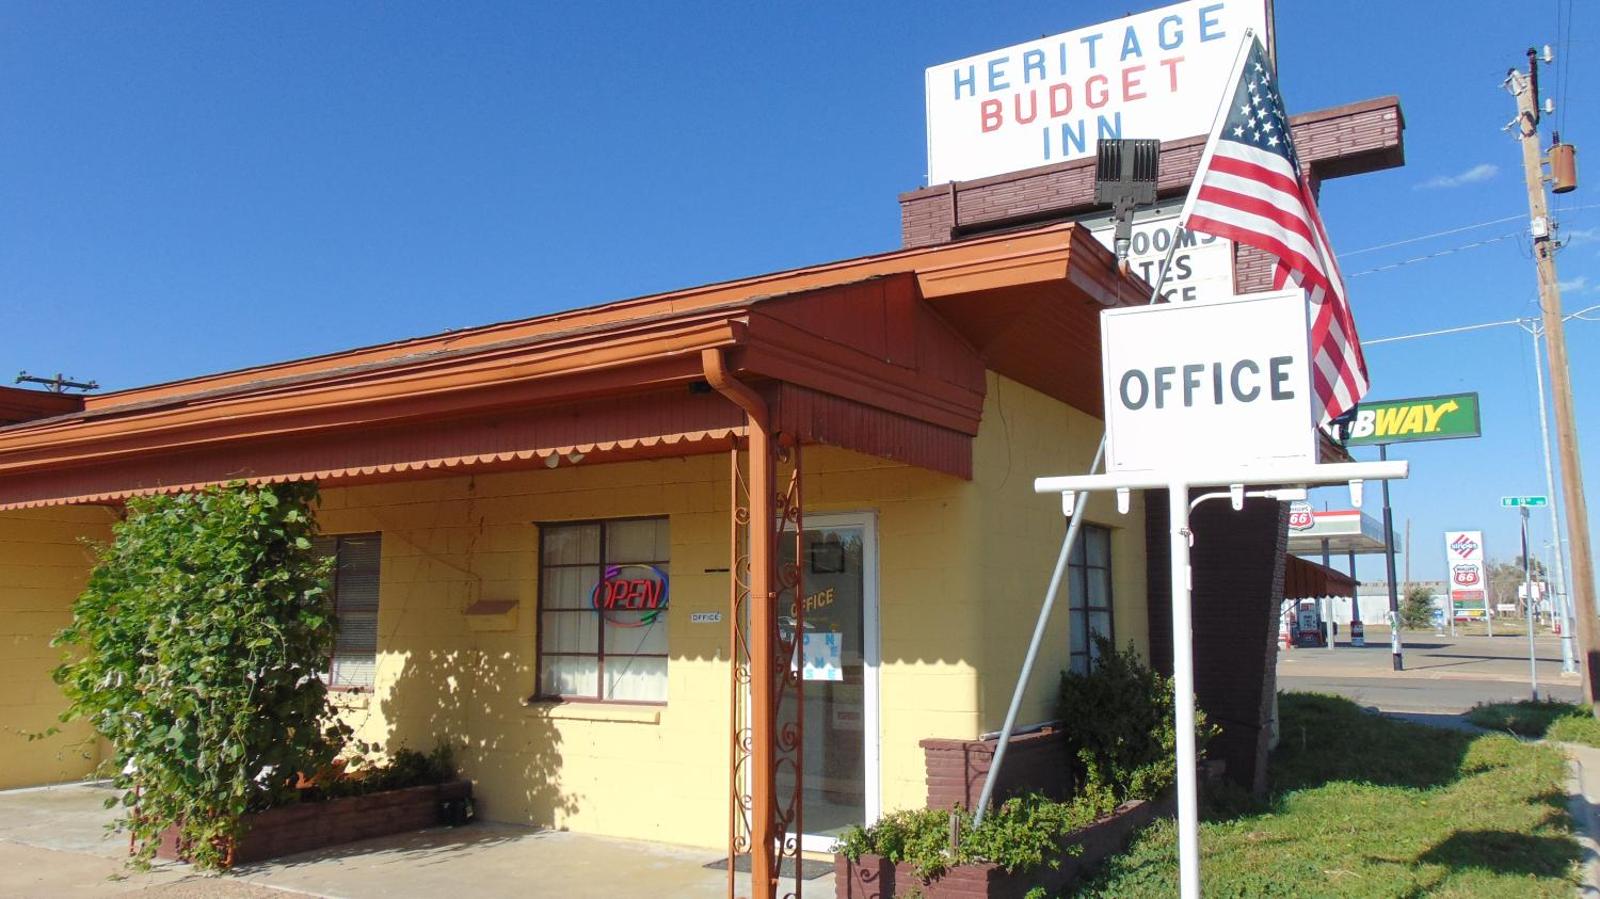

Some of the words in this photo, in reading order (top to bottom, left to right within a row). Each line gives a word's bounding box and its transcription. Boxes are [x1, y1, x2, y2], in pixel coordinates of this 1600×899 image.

[953, 3, 1226, 100] HERITAGE
[981, 56, 1187, 133] BUDGET
[1043, 111, 1122, 160] INN
[1133, 227, 1217, 255] OOM
[1119, 355, 1295, 411] OFFICE
[1290, 514, 1307, 524] 66
[1458, 573, 1475, 582] 66
[592, 578, 664, 609] OPEN
[790, 587, 834, 618] OFICE
